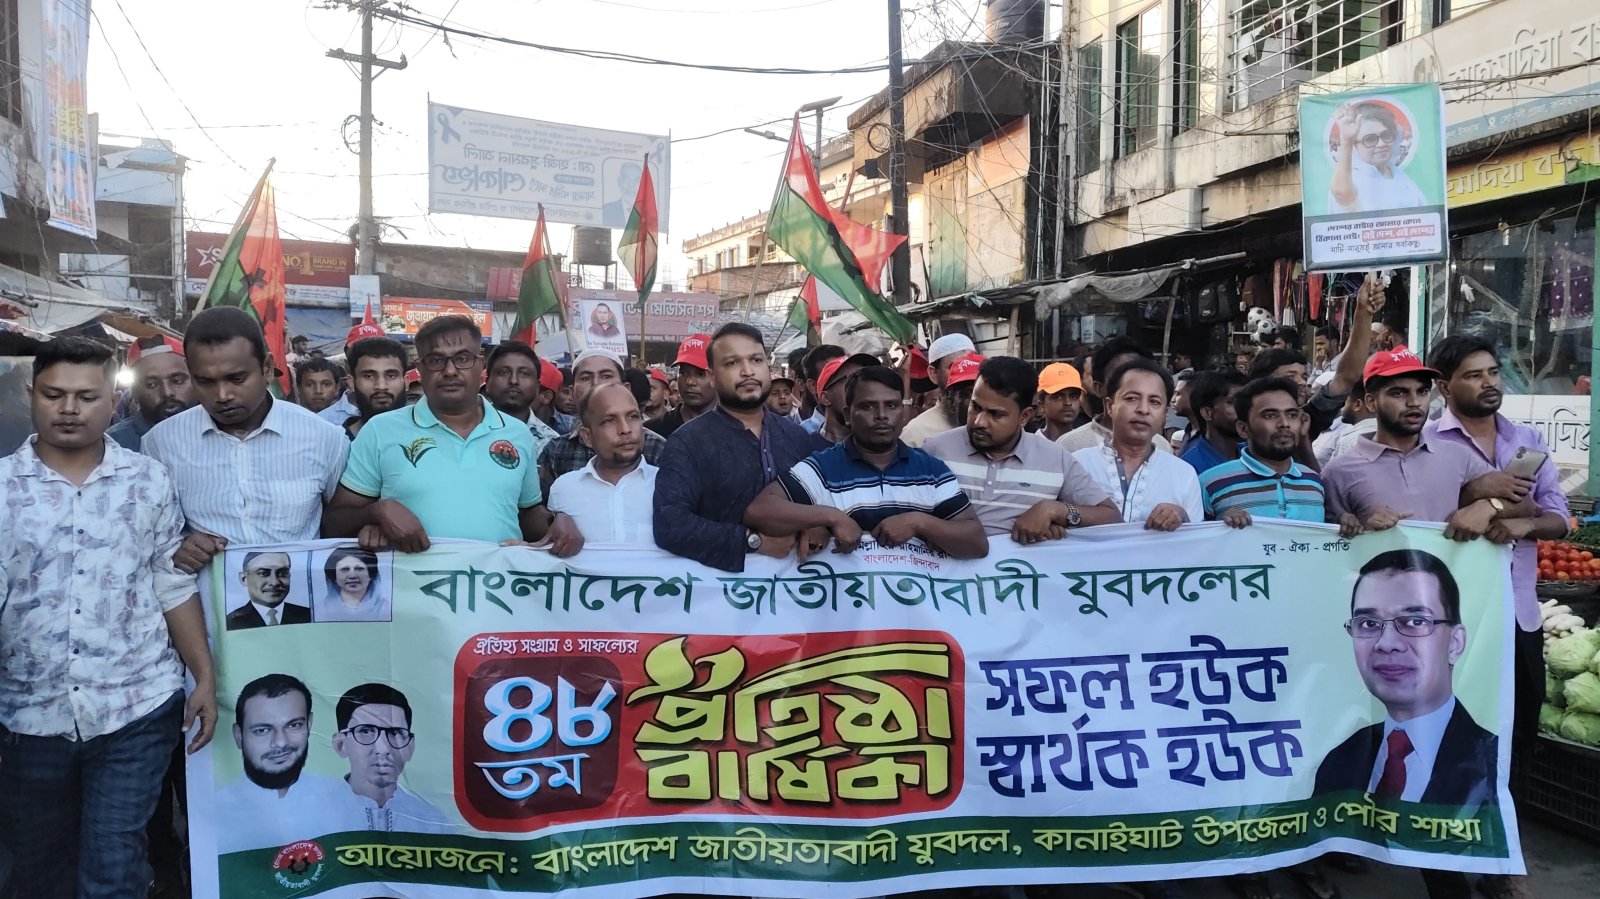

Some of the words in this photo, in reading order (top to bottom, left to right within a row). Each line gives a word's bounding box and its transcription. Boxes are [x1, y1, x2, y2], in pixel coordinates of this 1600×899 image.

[313, 256, 337, 266] BRAND
[651, 298, 695, 317] মেডিসিন
[697, 303, 716, 318] শপ
[1262, 543, 1277, 556] যুব
[1322, 538, 1351, 552] প্রগতি
[412, 564, 703, 616] বাংলাদেশ
[716, 557, 1048, 618] জাতীয়তাবাদী
[1061, 563, 1275, 618] যুবদলের
[473, 636, 517, 656] ঐতিহ্য
[521, 637, 559, 655] সংগ্রাম
[563, 639, 573, 653] ও
[577, 637, 639, 655] সাফল্যের
[979, 653, 1135, 717] সফল
[1141, 634, 1290, 711] হউক
[481, 673, 618, 754] ৪৮
[626, 636, 953, 746] প্রতিষ্ঠা
[473, 752, 591, 800] তম
[976, 712, 1150, 798] স্বার্থক
[1157, 708, 1304, 787] হউক
[531, 835, 679, 875] বাংলাদেশ
[688, 826, 899, 865] জাতীয়তাবাদী
[1033, 820, 1184, 853] কানাইঘাট
[1191, 812, 1309, 846] উপজেলা
[1312, 807, 1327, 829] ও
[1334, 793, 1400, 834] পৌর
[1410, 813, 1483, 843] শাখা
